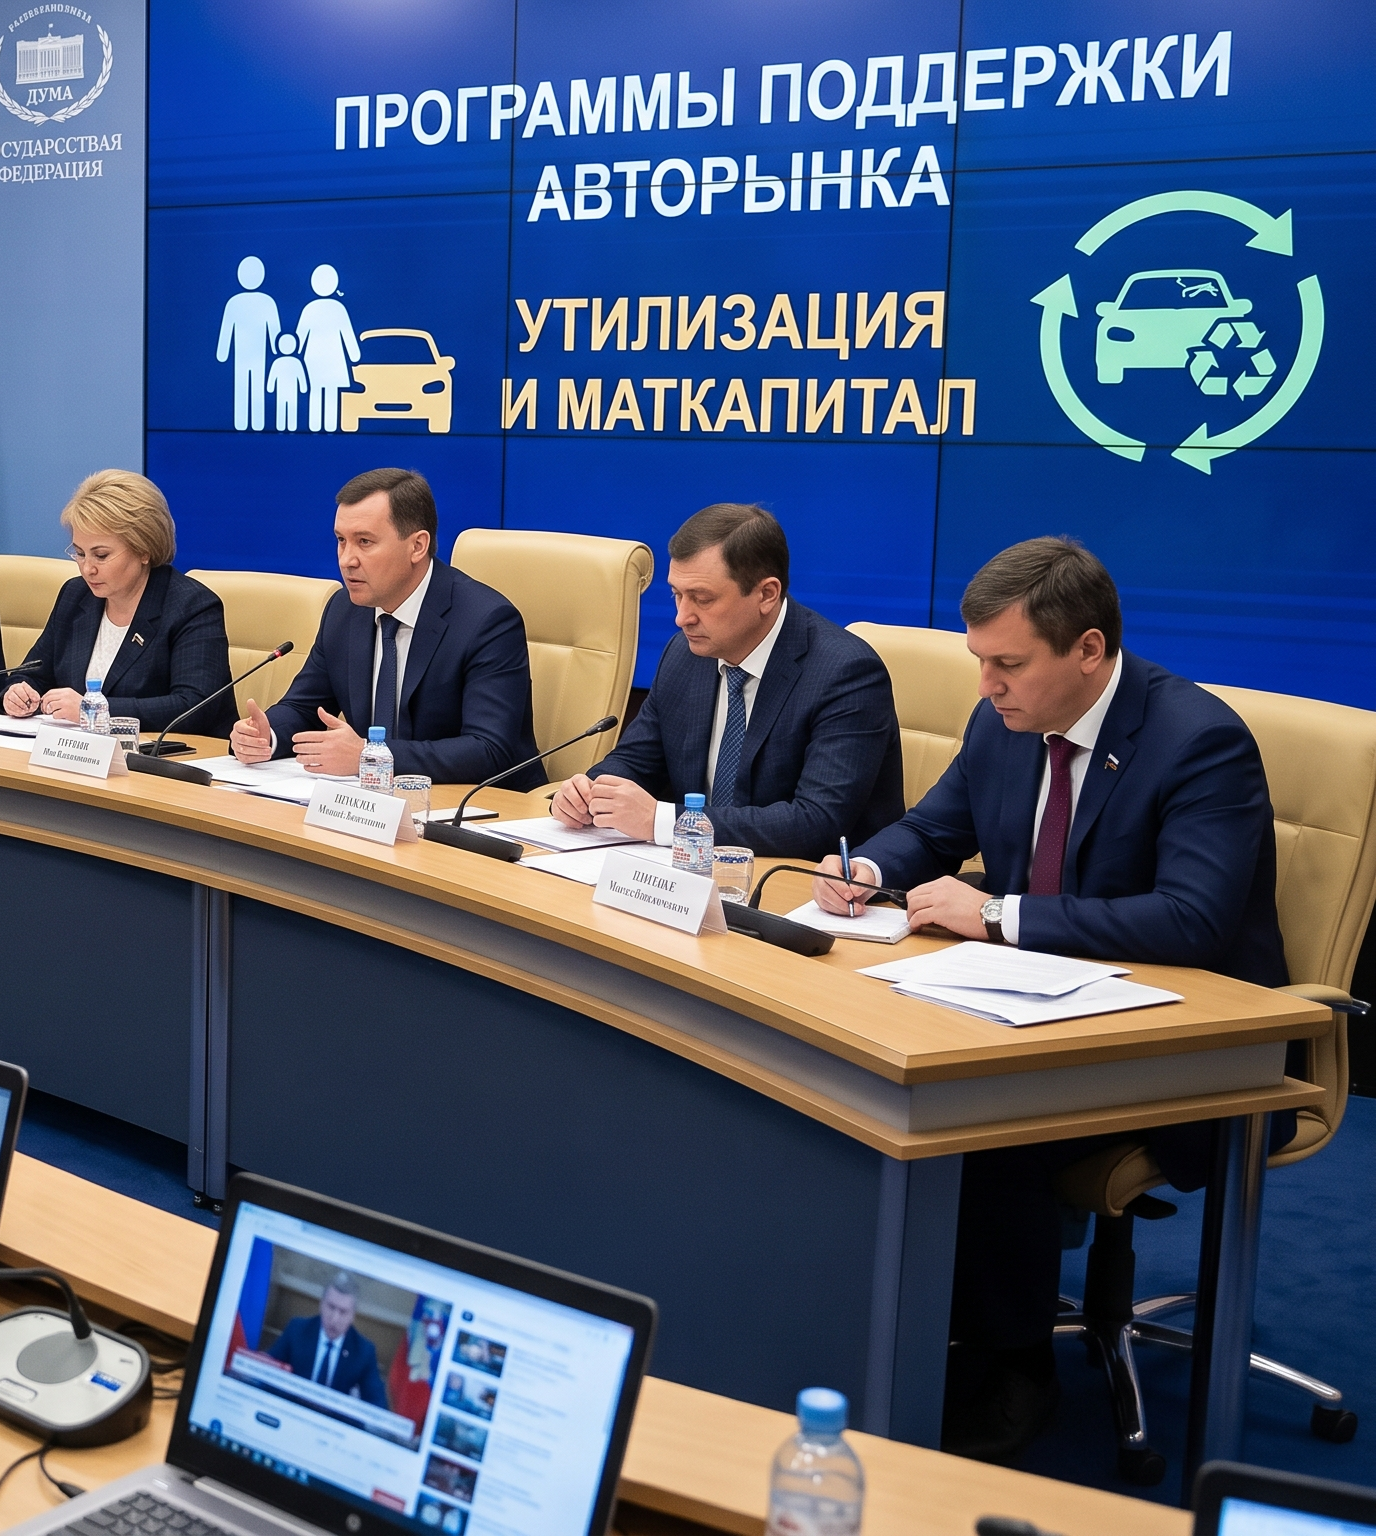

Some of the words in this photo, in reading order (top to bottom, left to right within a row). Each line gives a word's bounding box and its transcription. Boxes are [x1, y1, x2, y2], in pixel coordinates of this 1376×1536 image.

[26, 85, 74, 106] ДУМА
[335, 67, 736, 151] ПРОГРАММЫ
[759, 30, 1233, 130] ПОДДЕРЖКИ
[527, 145, 951, 222] АВТОРЫНКА
[515, 290, 946, 360] УТИЛИЗАЦИЯ
[501, 378, 538, 430] И
[558, 378, 977, 436] МАТКАПИТАЛ
